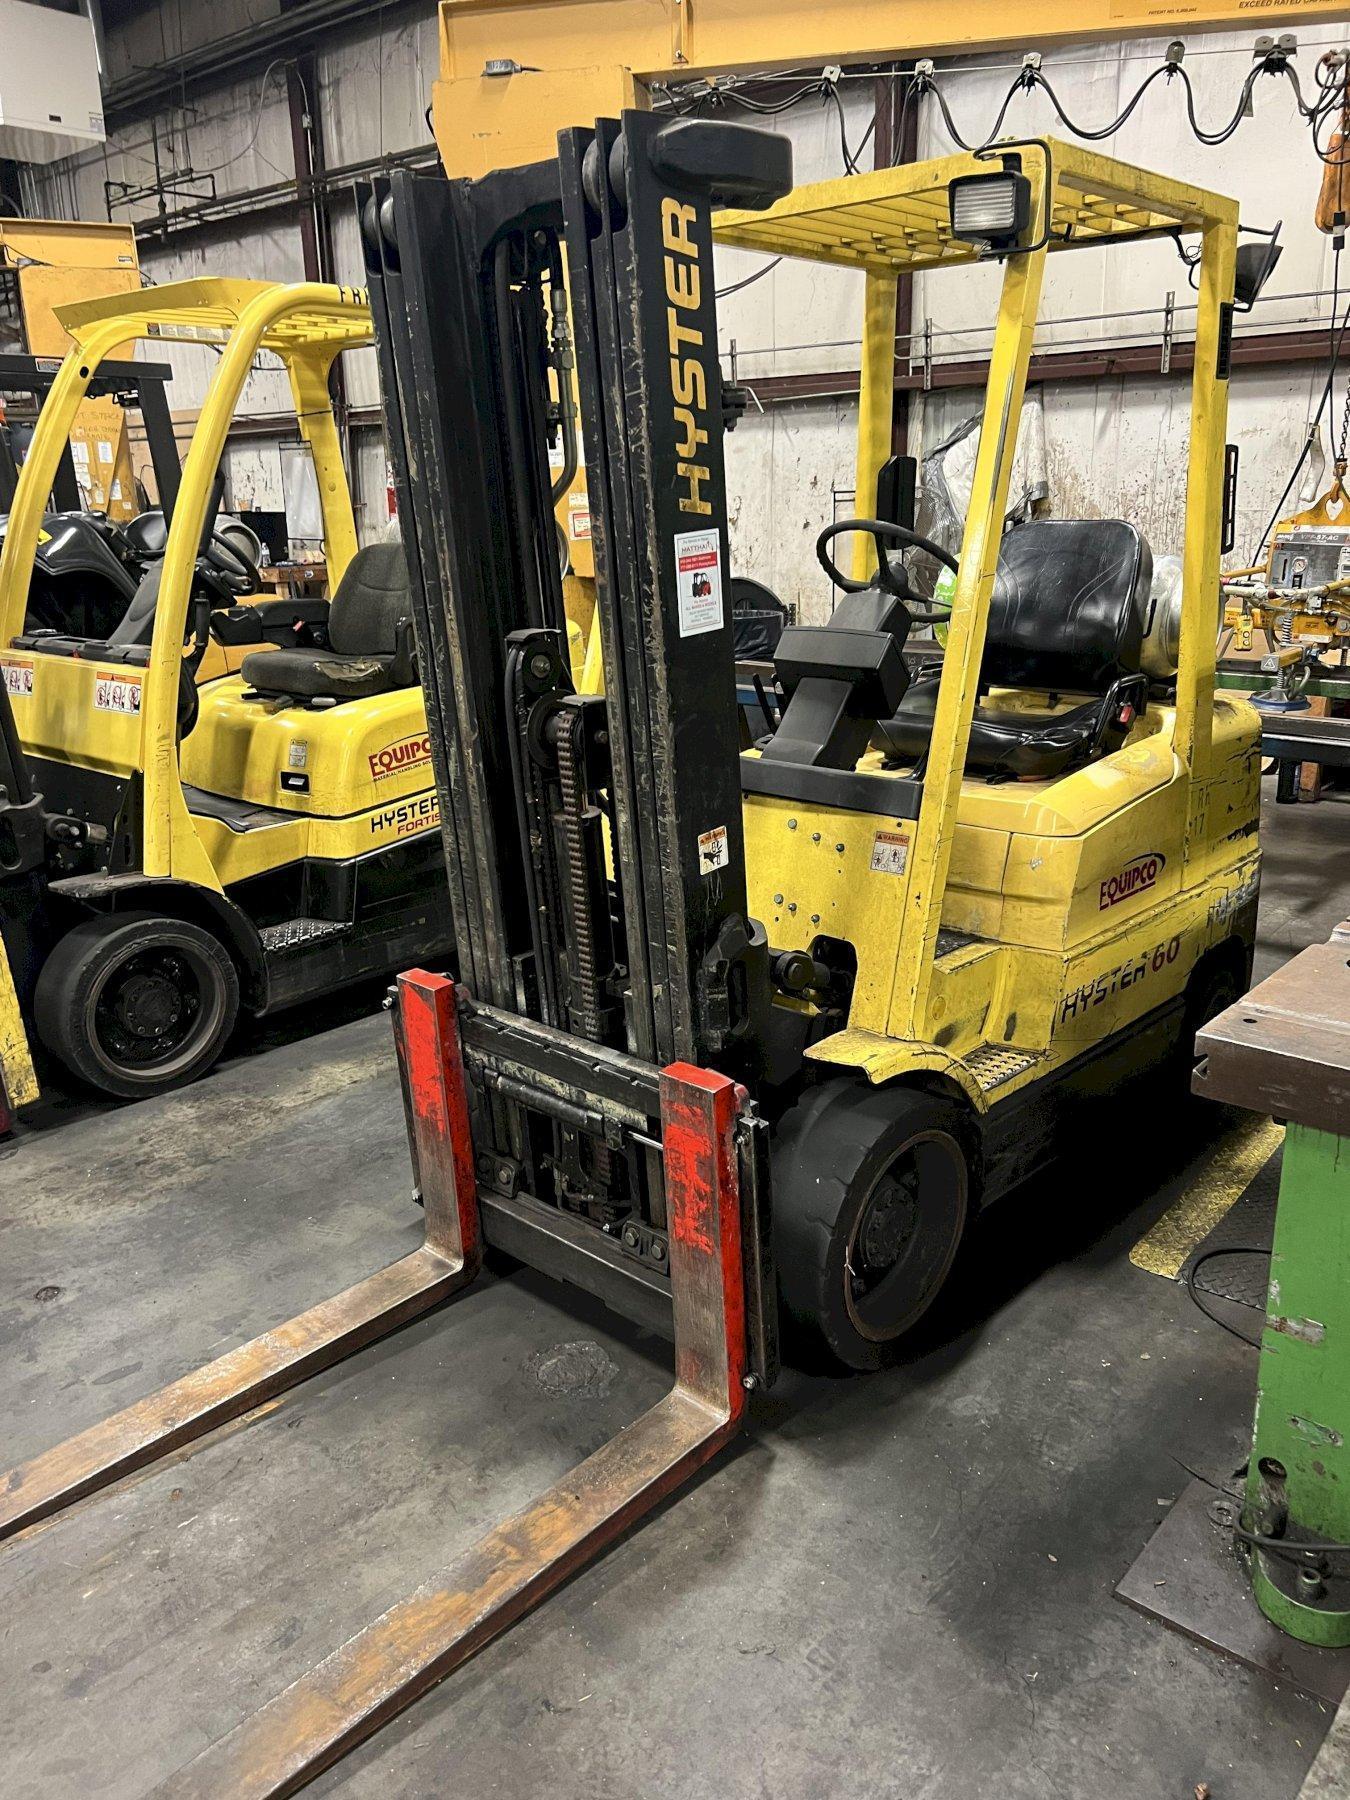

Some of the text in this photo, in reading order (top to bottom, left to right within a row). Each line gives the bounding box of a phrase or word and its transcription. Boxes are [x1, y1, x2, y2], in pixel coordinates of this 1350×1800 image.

[1239, 0, 1272, 9] EXCEED
[661, 196, 712, 515] HYSTER
[883, 834, 908, 844] WARNING
[1099, 859, 1158, 911] EQUIPCO
[1061, 937, 1181, 1024] HYSTER 60
